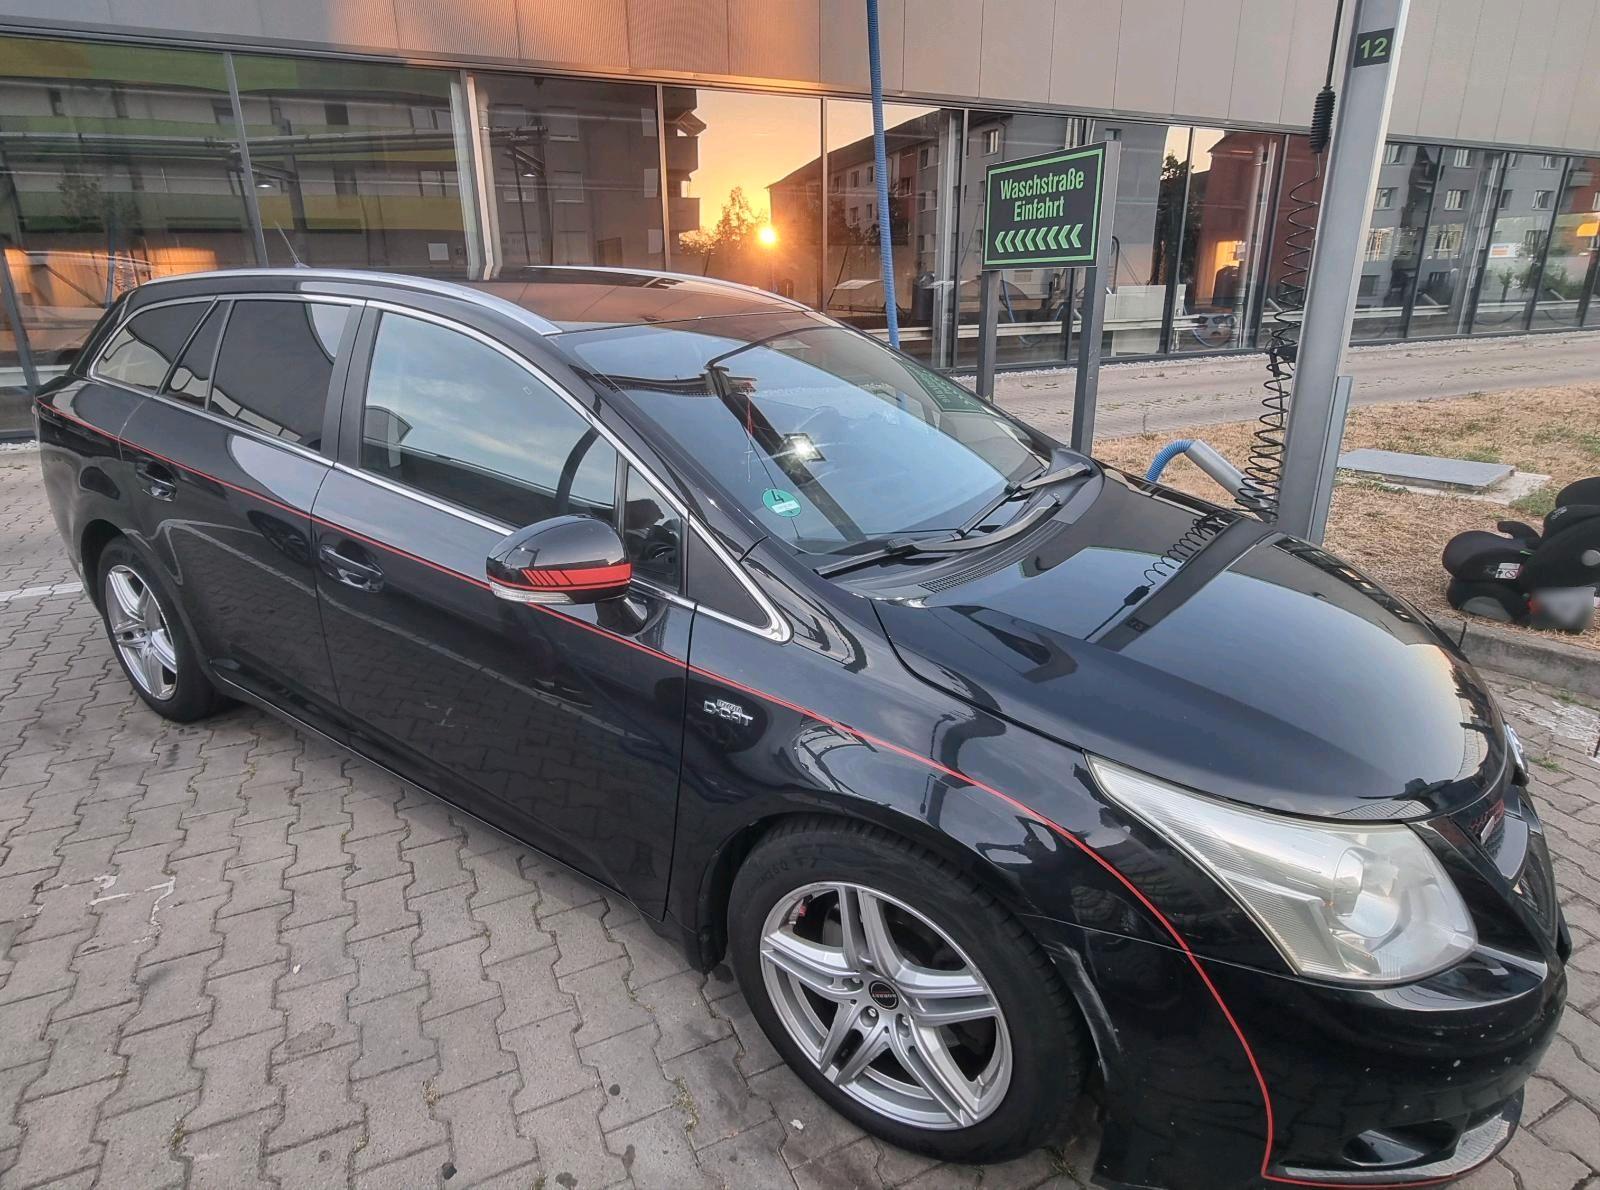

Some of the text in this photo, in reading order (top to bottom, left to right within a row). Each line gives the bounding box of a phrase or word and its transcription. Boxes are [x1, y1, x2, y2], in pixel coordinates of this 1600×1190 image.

[1360, 37, 1388, 59] 12
[1000, 167, 1084, 200] Waschstraße
[1014, 196, 1065, 222] Einfahrt
